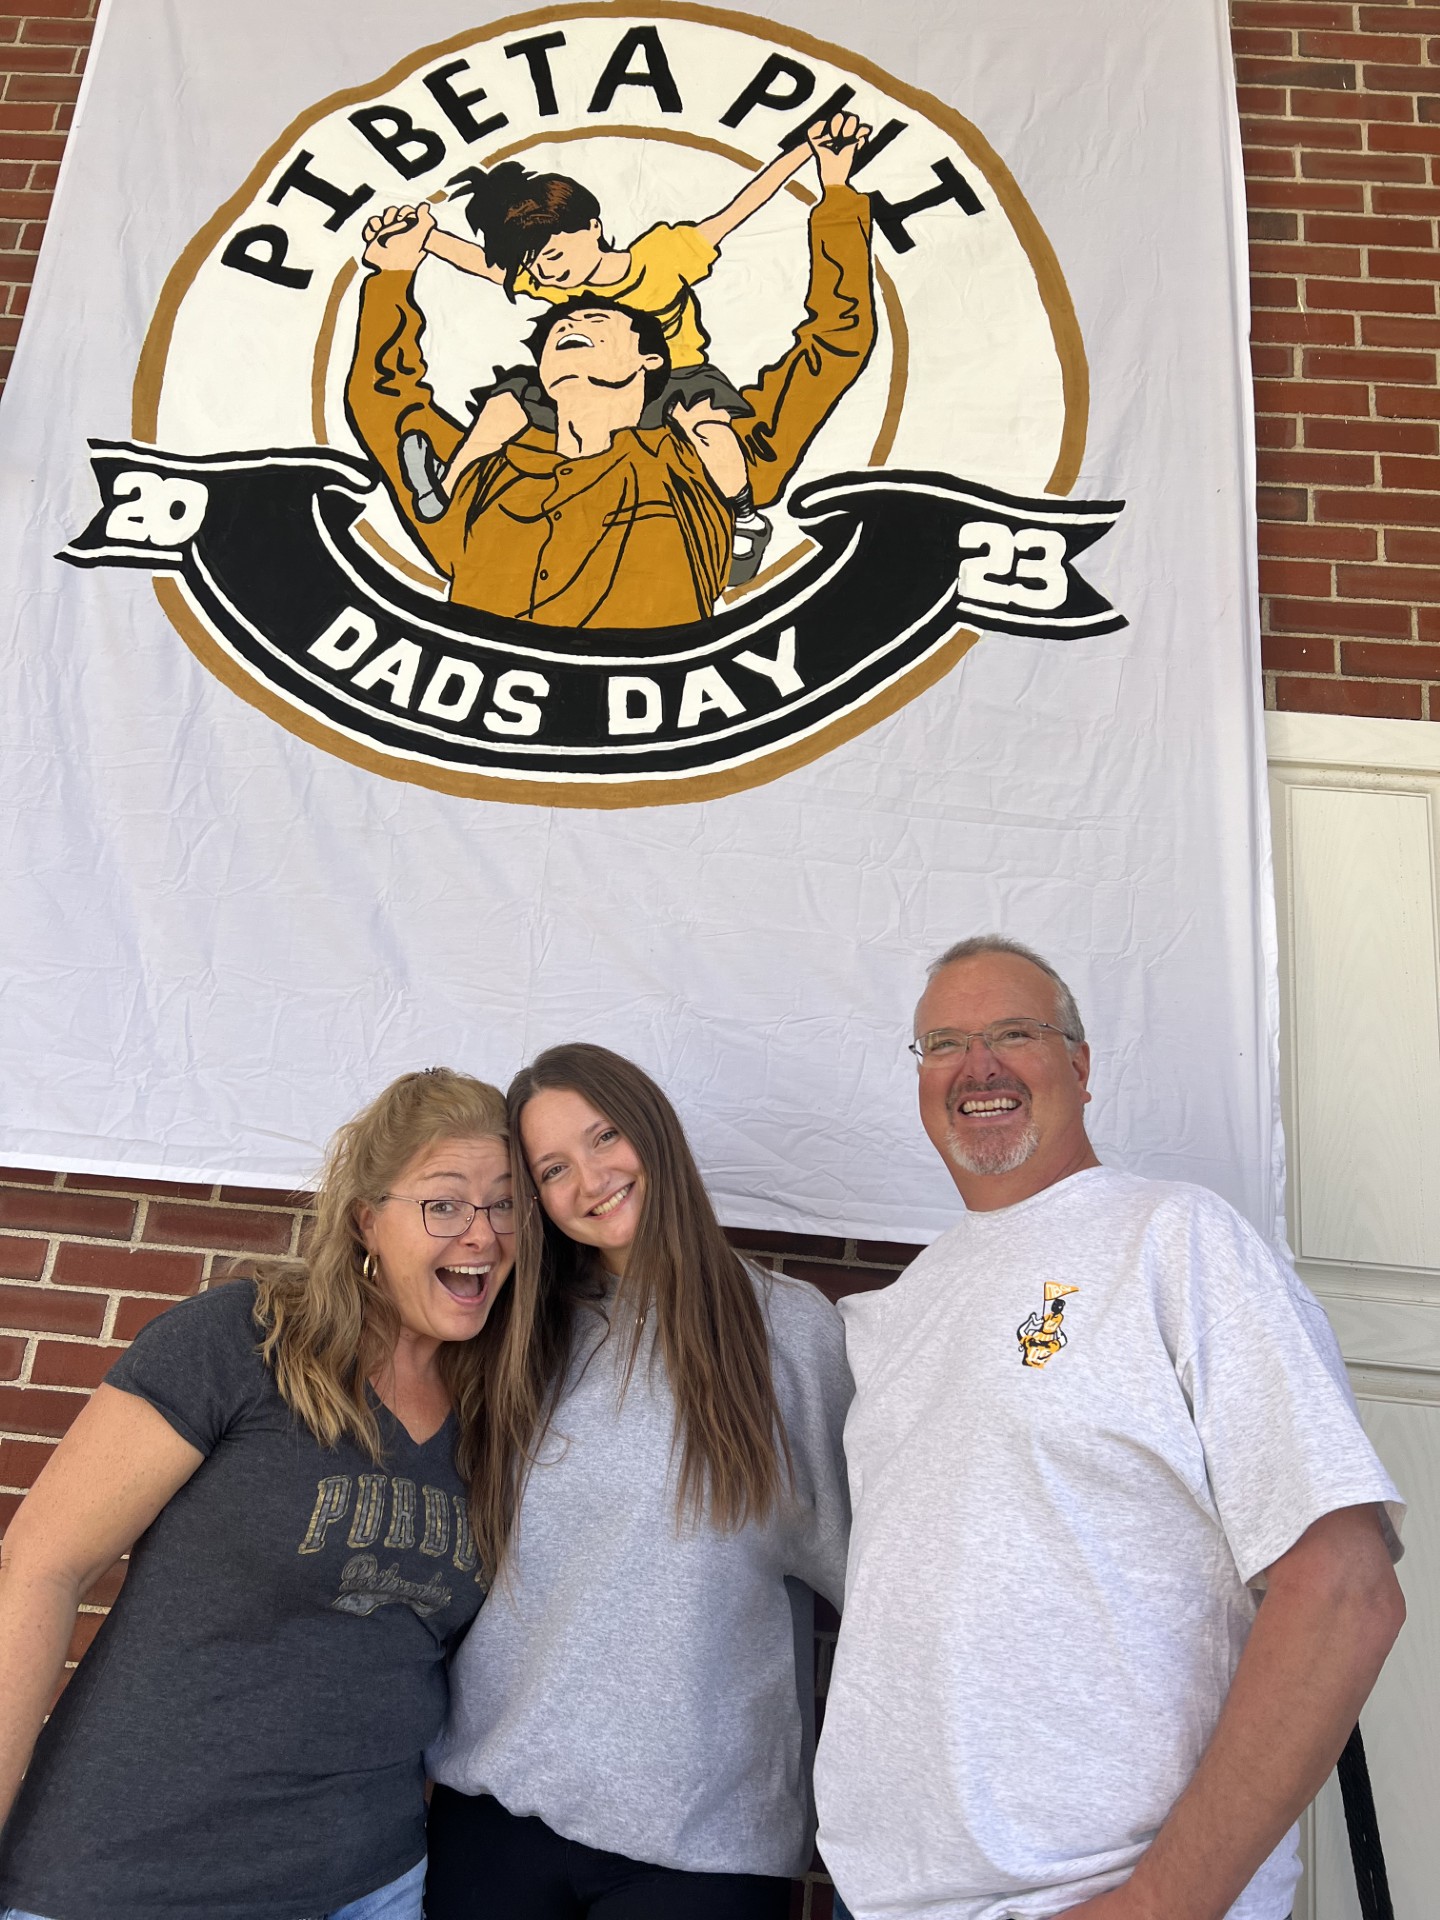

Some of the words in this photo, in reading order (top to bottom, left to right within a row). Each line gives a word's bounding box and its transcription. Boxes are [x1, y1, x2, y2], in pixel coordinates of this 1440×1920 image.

[221, 148, 375, 290] PI
[347, 25, 683, 180] BETA
[104, 471, 209, 546] 20
[957, 520, 1069, 610] 23
[306, 605, 551, 737] DADS
[606, 627, 805, 736] DAY
[298, 1474, 489, 1595] PURDU
